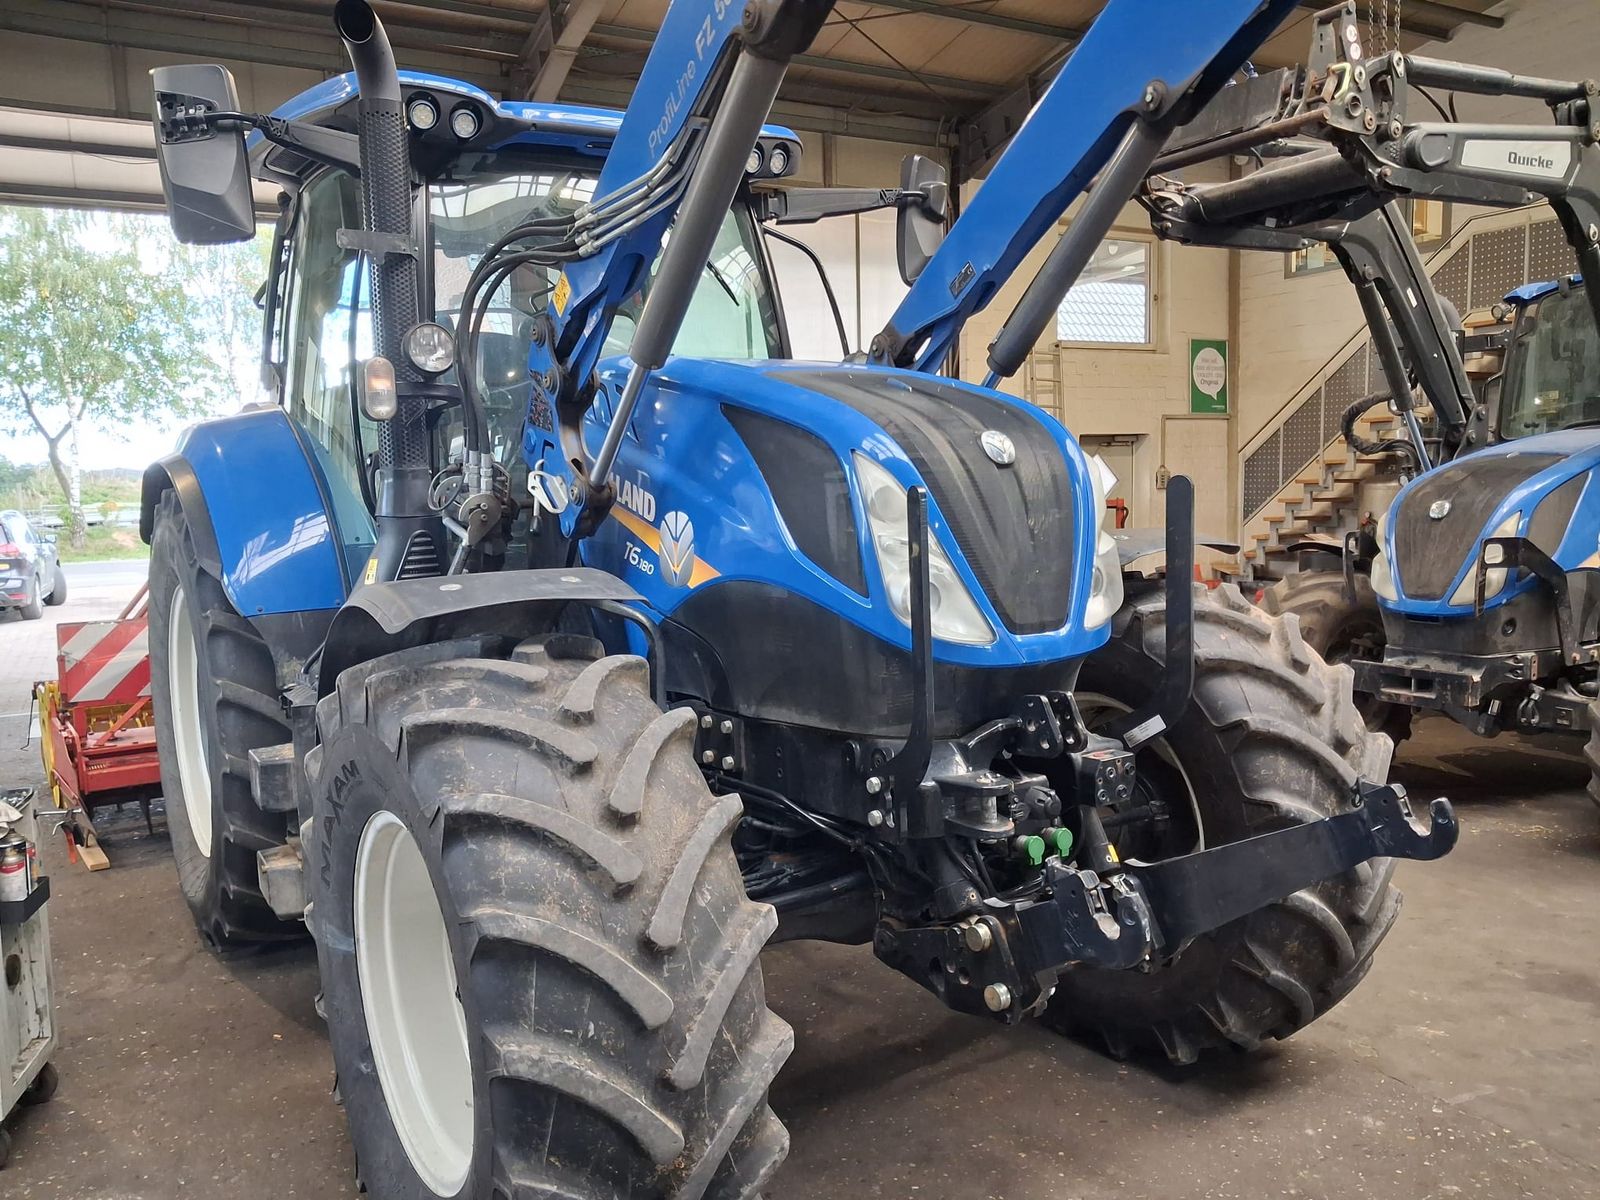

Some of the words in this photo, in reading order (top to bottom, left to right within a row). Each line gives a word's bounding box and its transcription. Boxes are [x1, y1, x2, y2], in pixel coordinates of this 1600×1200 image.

[648, 59, 696, 159] ProfiLine
[695, 13, 716, 61] FZ
[1508, 151, 1554, 169] Quicke
[610, 472, 656, 522] LAND
[623, 541, 654, 575] T6.180
